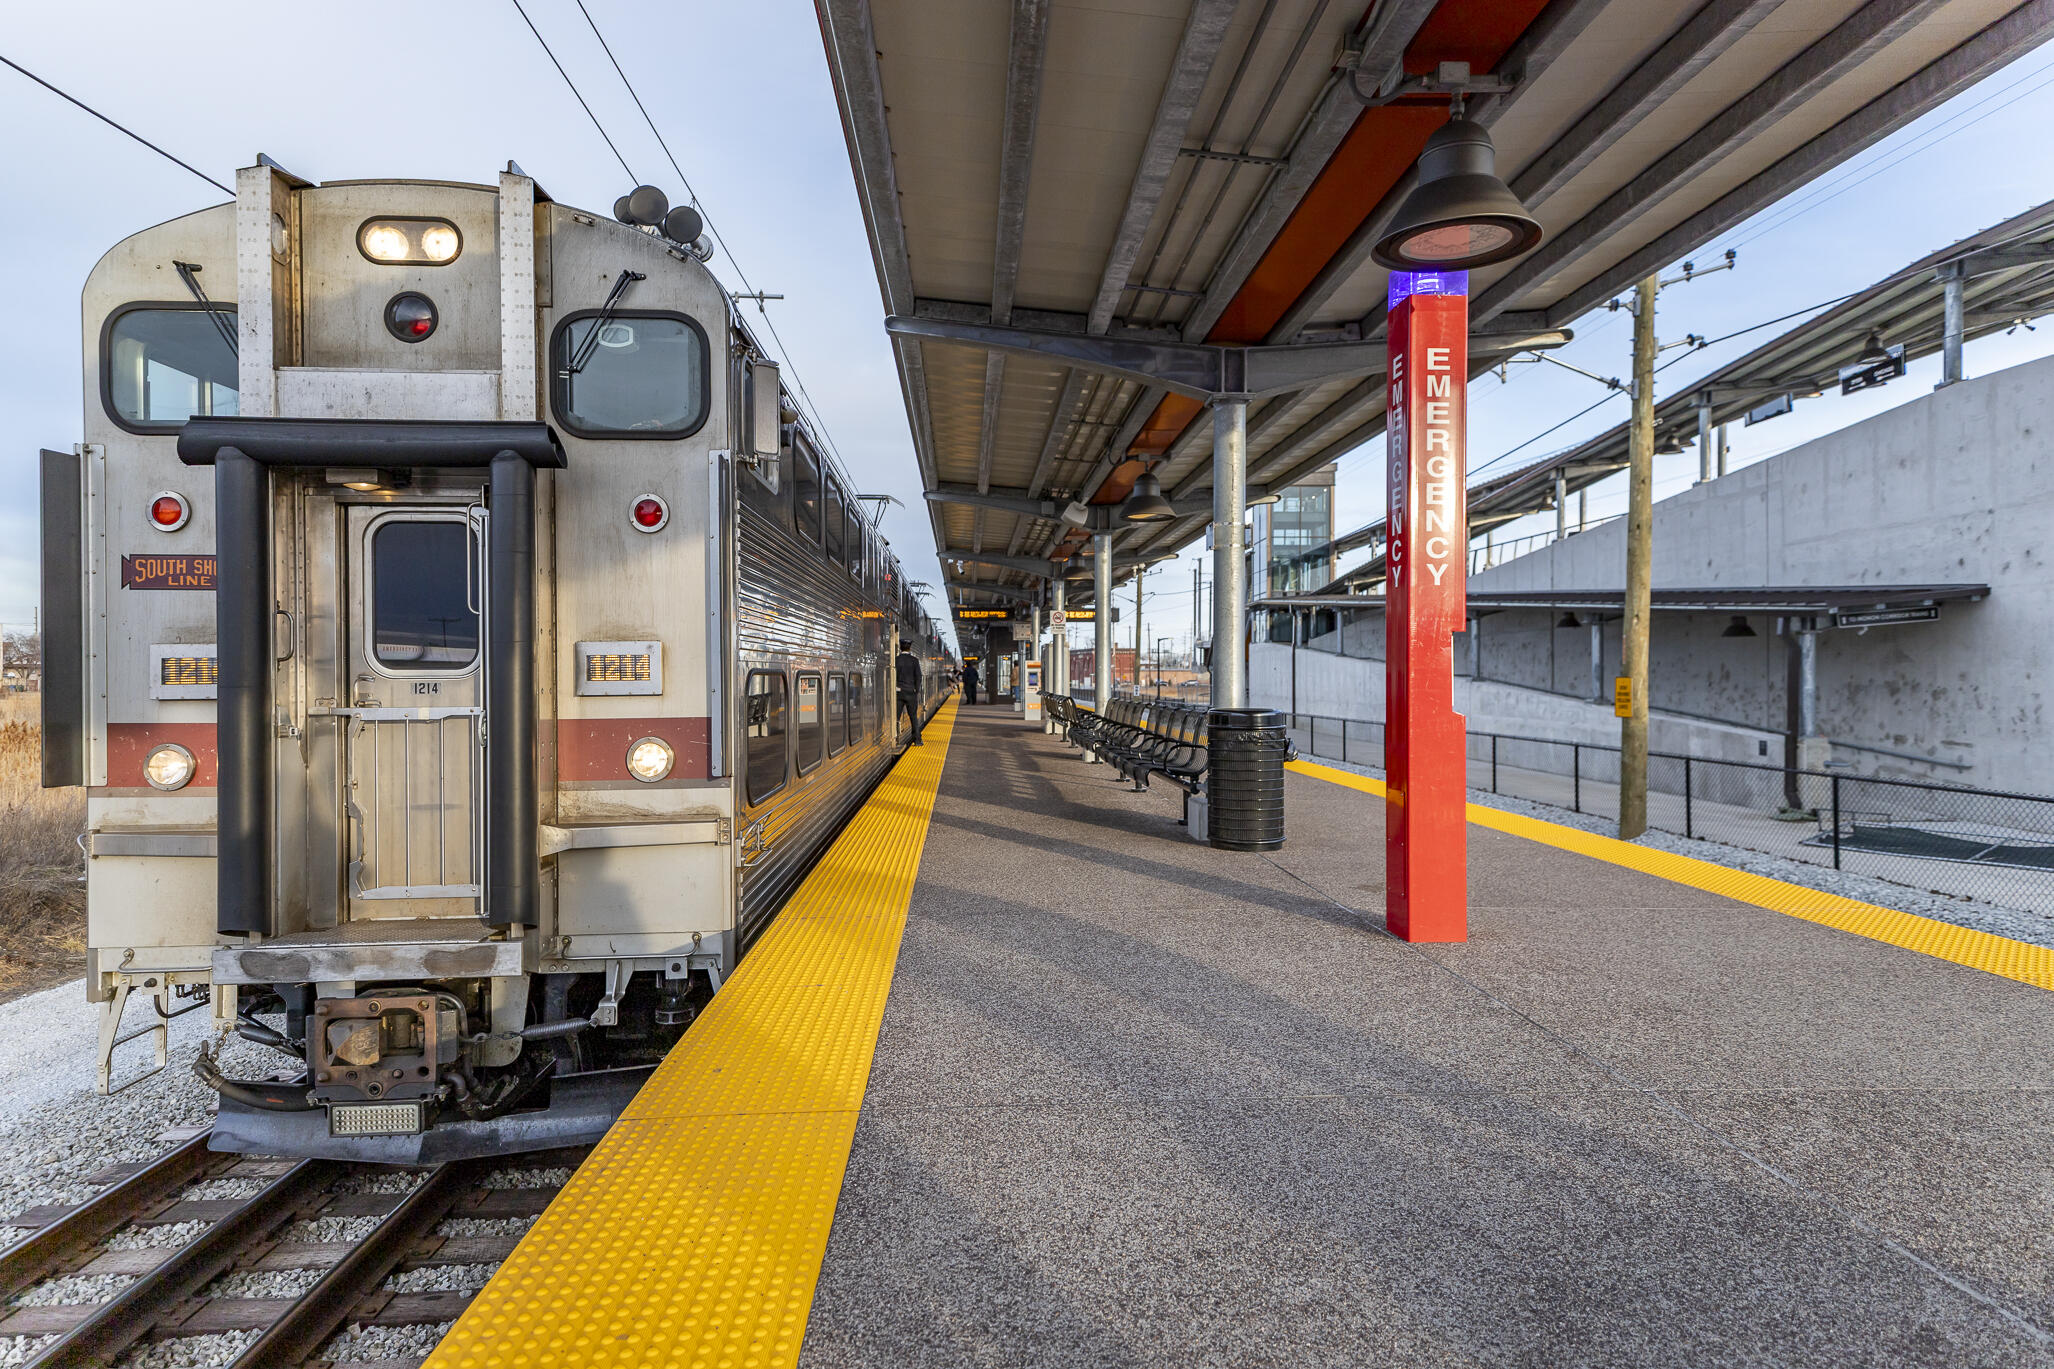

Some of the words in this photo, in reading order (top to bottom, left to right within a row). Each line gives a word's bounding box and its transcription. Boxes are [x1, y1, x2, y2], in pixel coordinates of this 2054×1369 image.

[1391, 353, 1404, 589] EMERGENCY
[1425, 347, 1451, 587] EMERGENCY
[135, 559, 187, 583] SOUTH
[193, 559, 217, 576] SH
[167, 575, 212, 586] LINE
[590, 654, 650, 681] 1214
[414, 682, 438, 694] 1214
